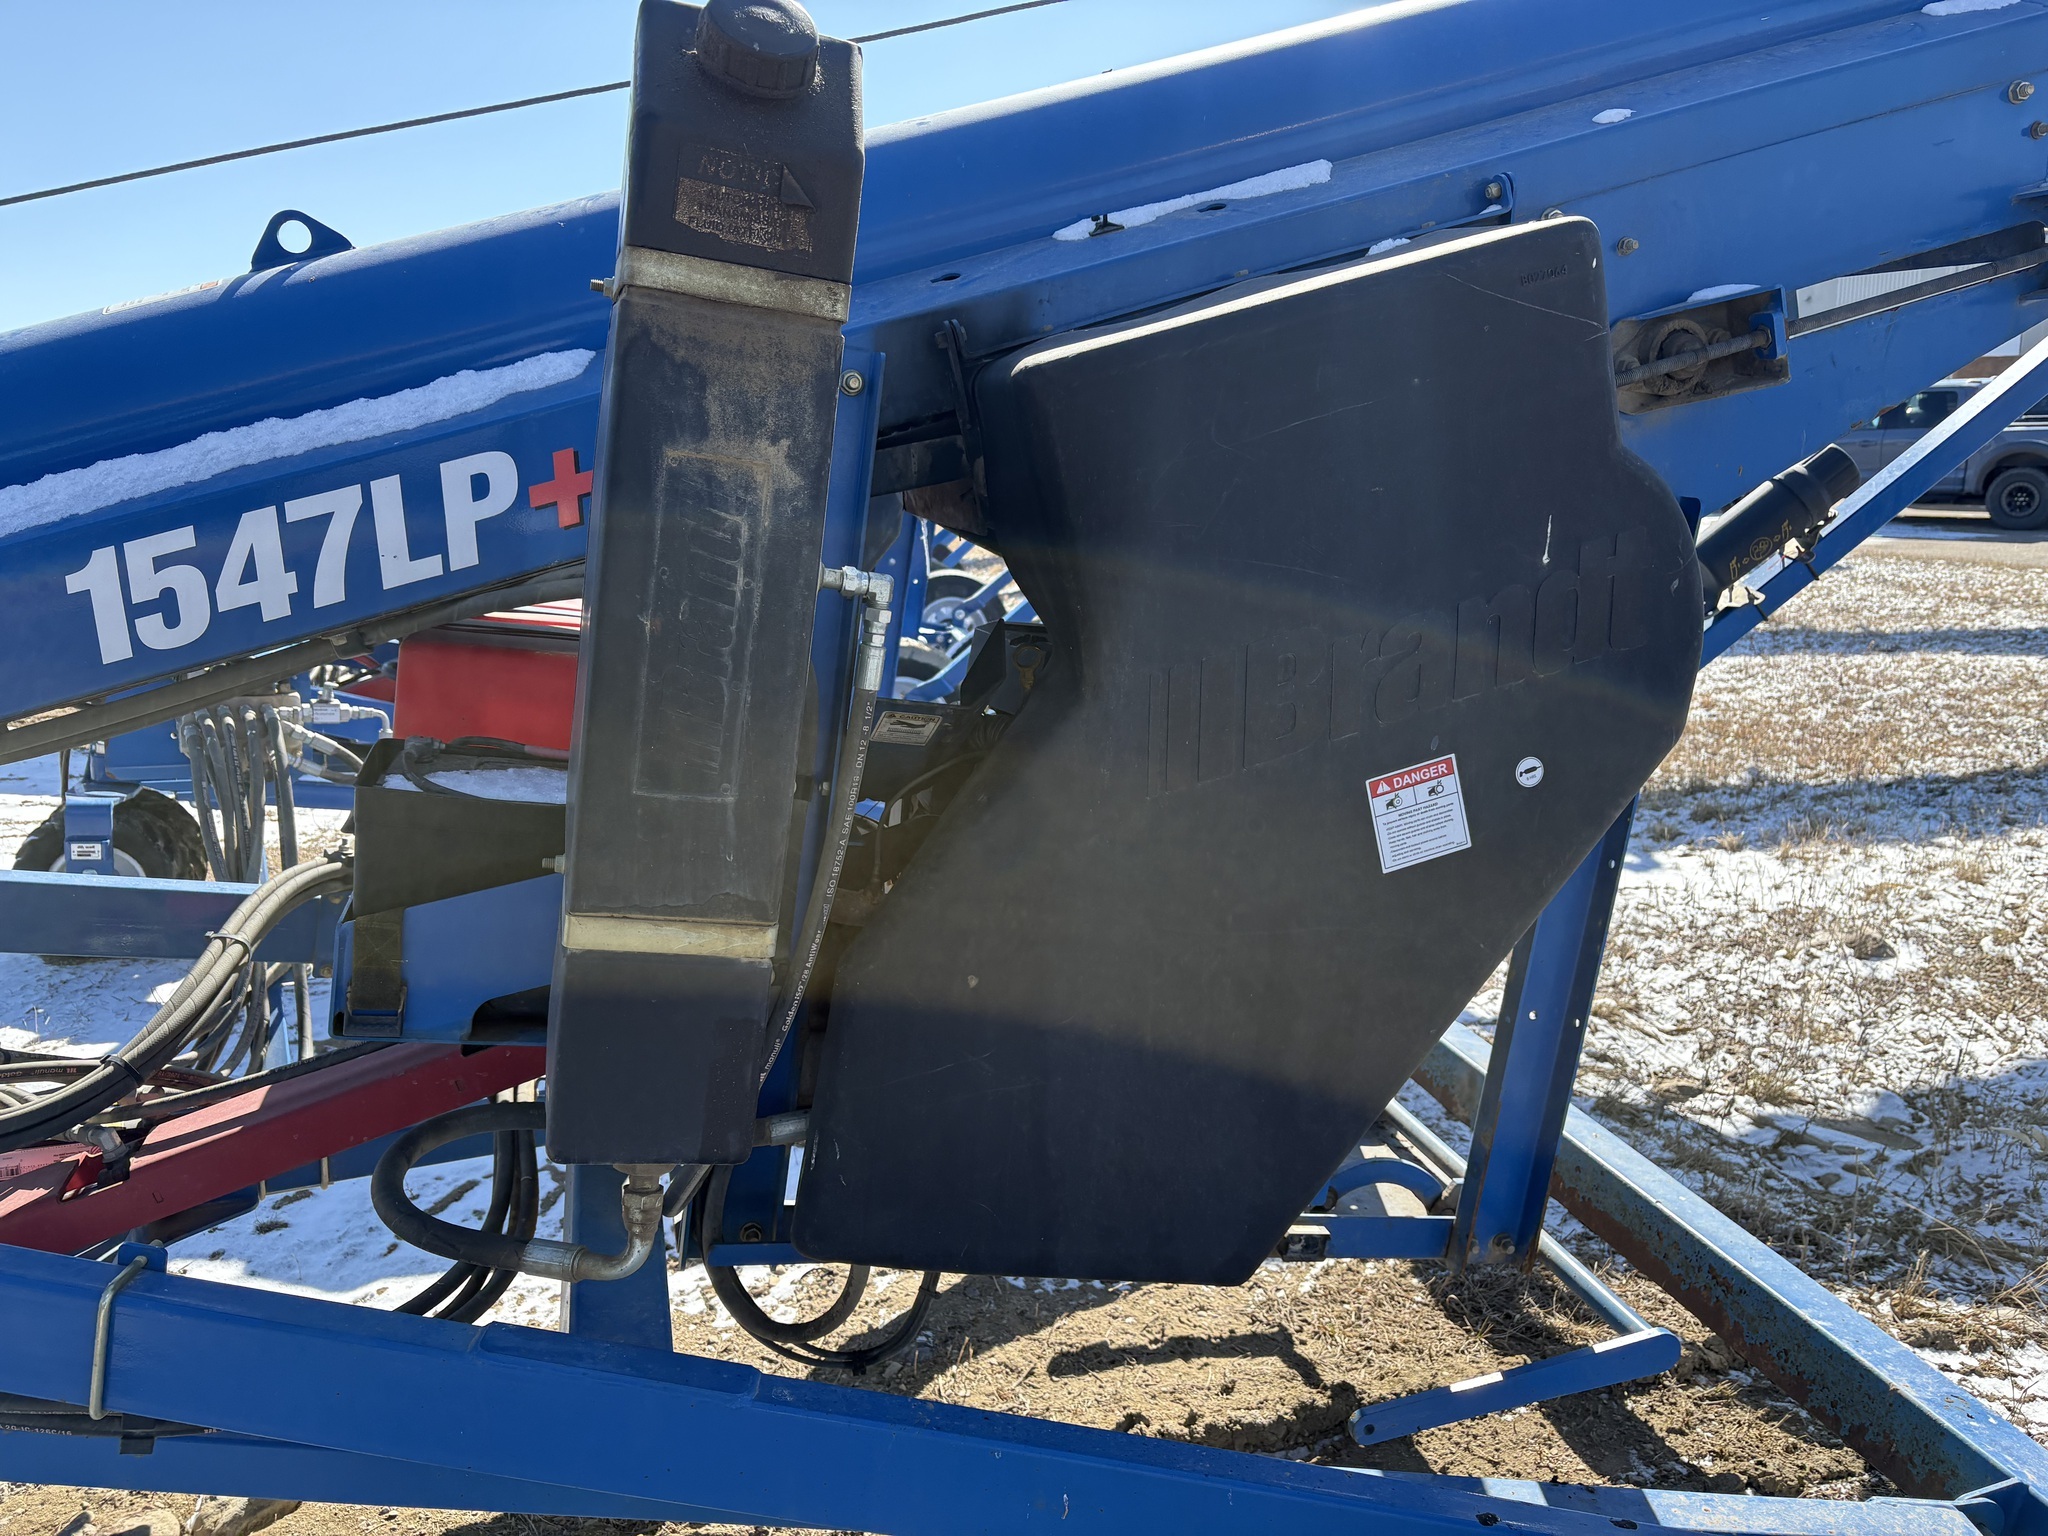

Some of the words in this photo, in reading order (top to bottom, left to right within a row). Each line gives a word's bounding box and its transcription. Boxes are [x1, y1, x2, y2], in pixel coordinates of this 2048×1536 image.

[1243, 526, 1652, 771] Brandt
[860, 740, 867, 751] 12
[856, 753, 865, 768] DN
[1393, 763, 1448, 789] DANGER
[842, 814, 853, 834] SAE
[832, 839, 847, 877] 18752-A
[827, 880, 837, 897] ISO
